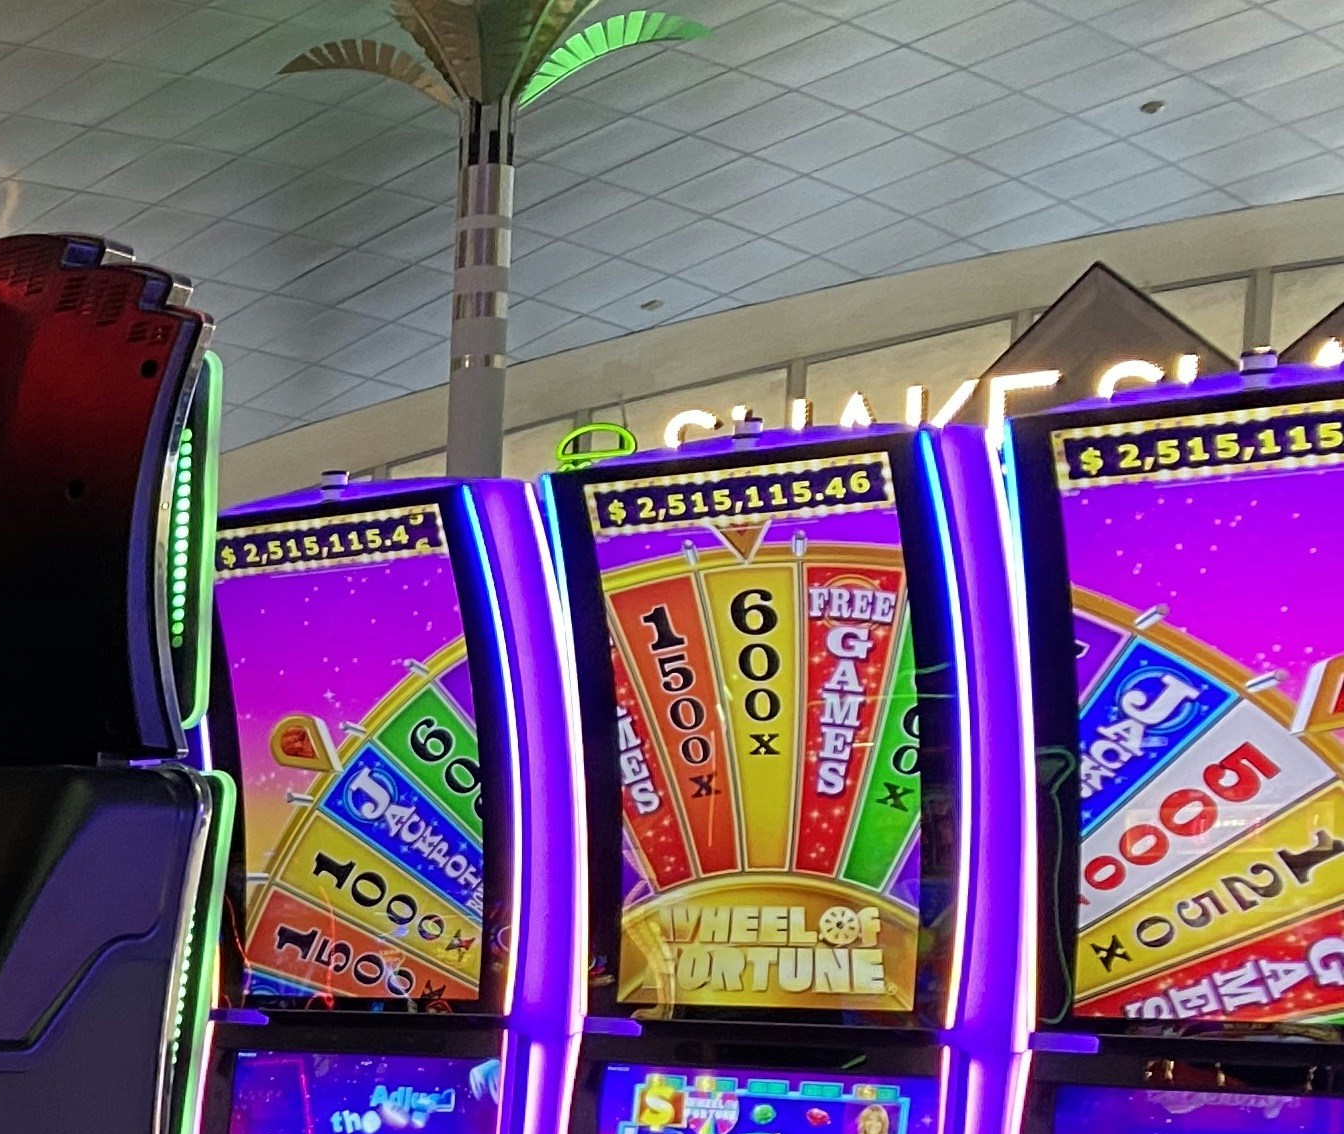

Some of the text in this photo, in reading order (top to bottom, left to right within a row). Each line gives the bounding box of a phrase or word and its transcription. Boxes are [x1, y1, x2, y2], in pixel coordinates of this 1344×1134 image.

[1080, 446, 1103, 471] $
[608, 470, 871, 526] $ 2,515,115.46
[220, 546, 237, 568] $
[808, 588, 897, 624] FREE
[816, 625, 872, 797] GAMES
[1080, 673, 1201, 799] JACK
[658, 905, 818, 947] WHEEL
[652, 943, 886, 996] FORTUNE
